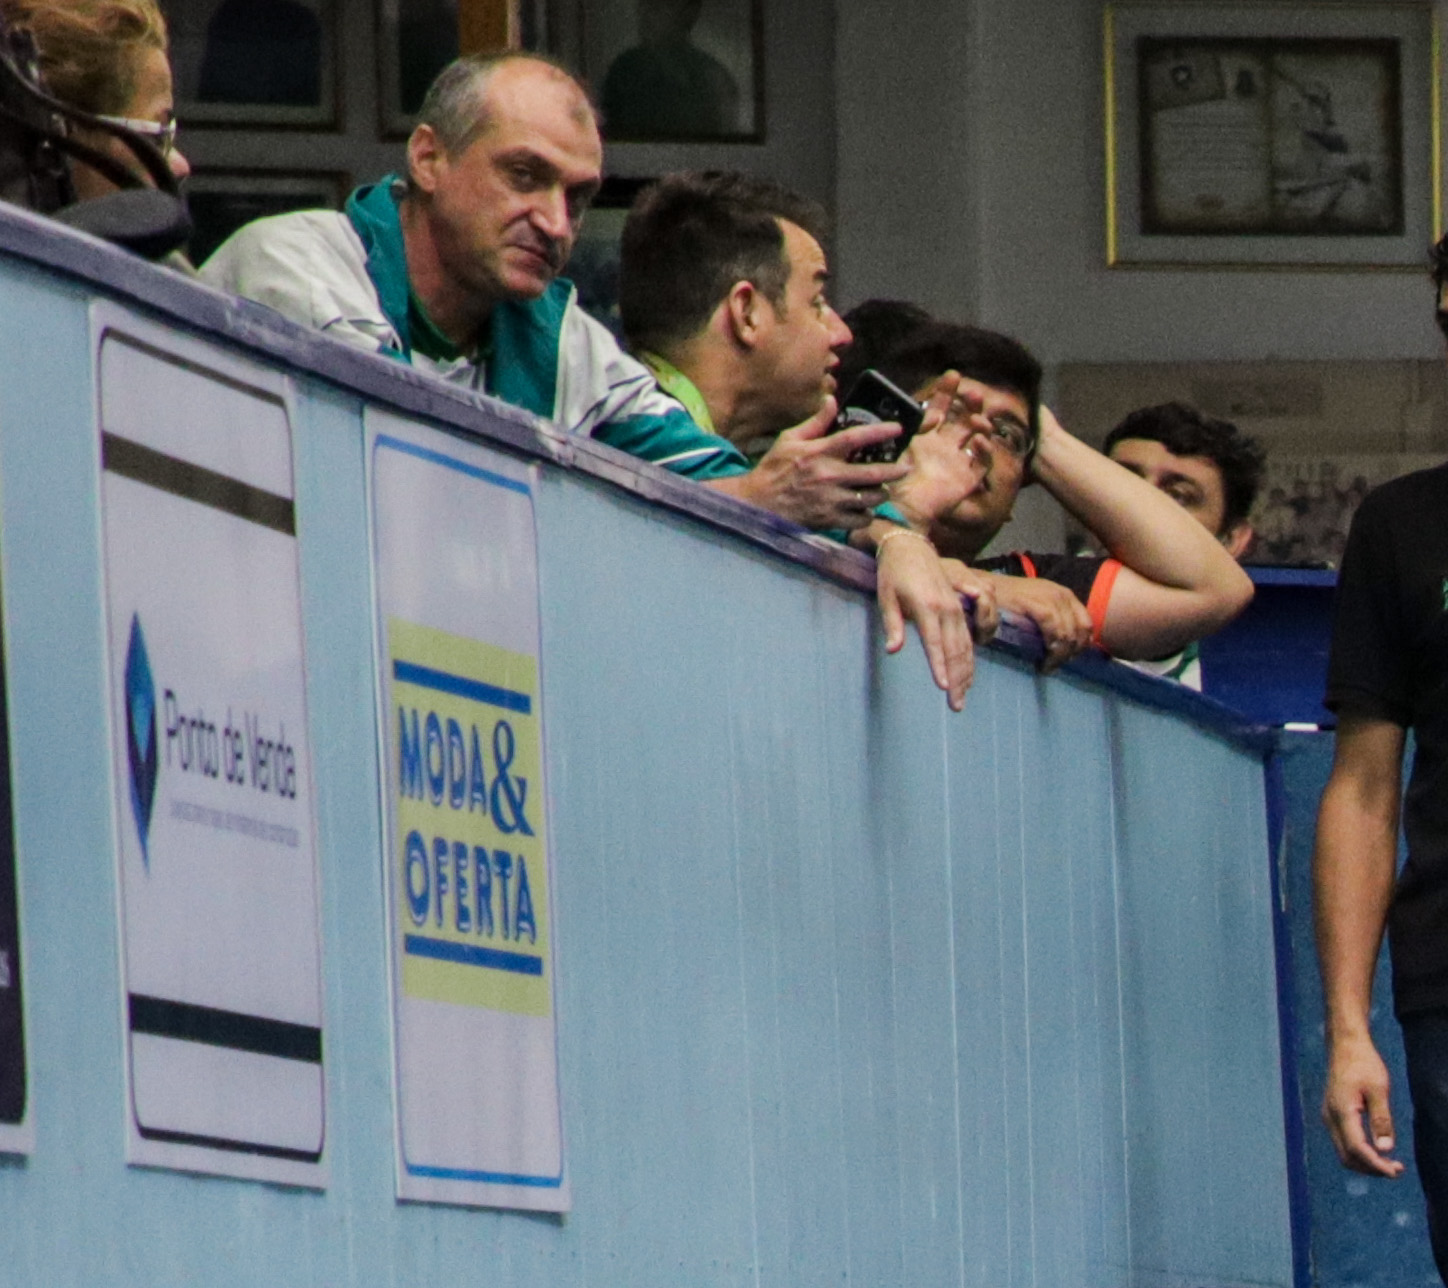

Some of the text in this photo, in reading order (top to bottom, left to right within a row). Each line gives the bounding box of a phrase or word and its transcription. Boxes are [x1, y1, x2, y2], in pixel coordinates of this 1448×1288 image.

[164, 688, 297, 800] Ponto de Venda
[404, 829, 537, 945] OFERTA
